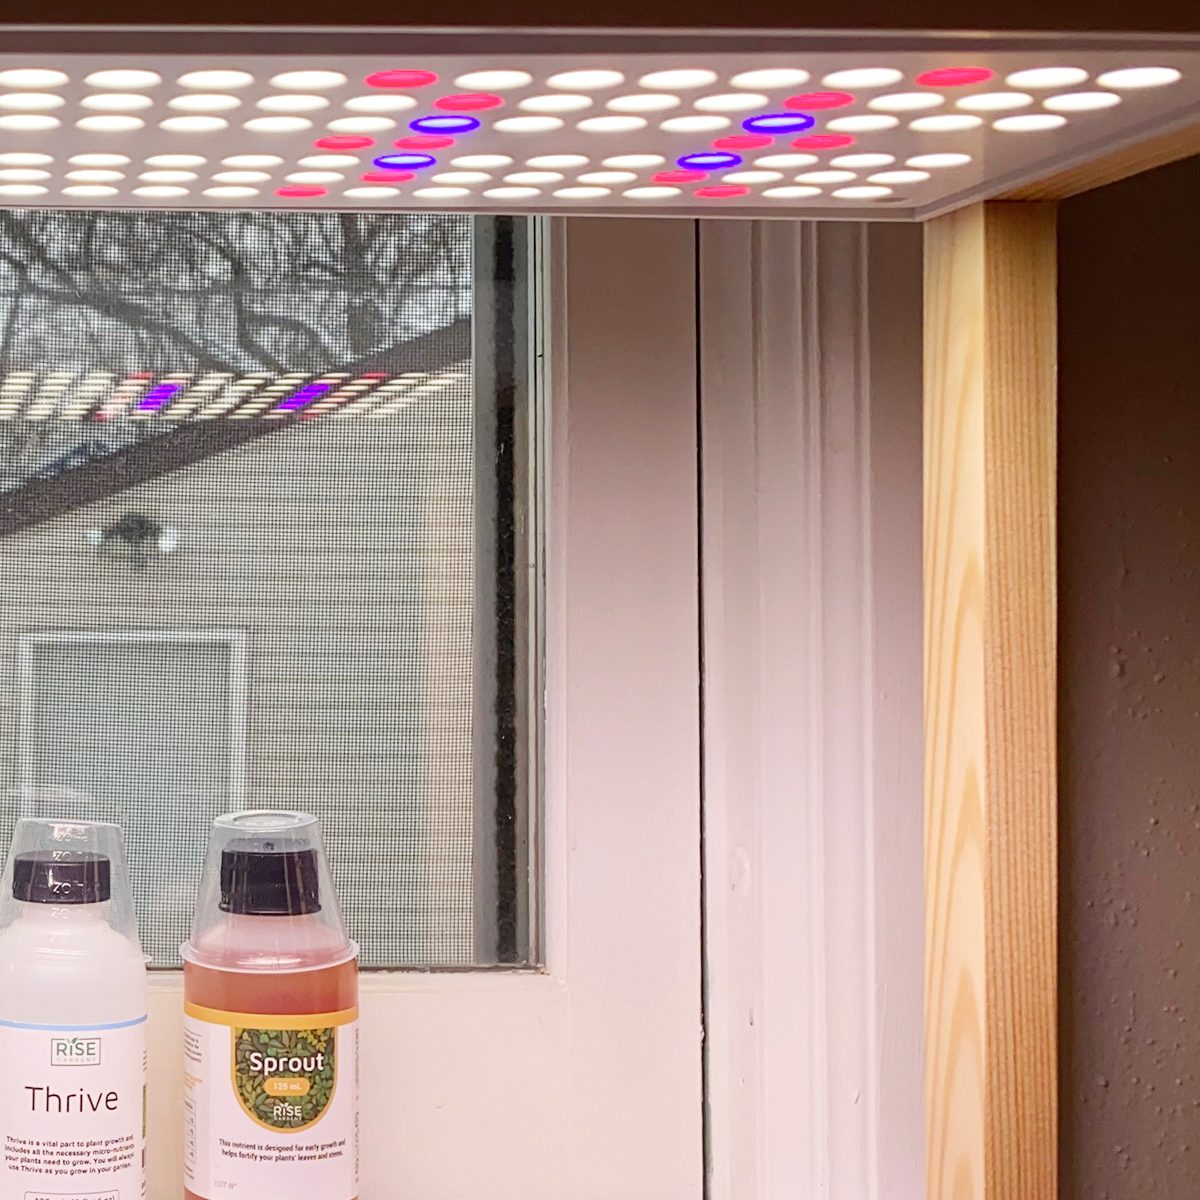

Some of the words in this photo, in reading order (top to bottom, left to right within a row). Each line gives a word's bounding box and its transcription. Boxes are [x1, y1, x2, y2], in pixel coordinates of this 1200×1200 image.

[249, 1052, 324, 1076] Sprout
[273, 1082, 288, 1090] 125
[25, 1086, 118, 1113] Thrive
[6, 1135, 26, 1145] Thrive
[60, 1140, 75, 1148] part
[85, 1138, 103, 1148] plant
[104, 1136, 124, 1146] growth
[219, 1138, 231, 1147] This
[232, 1141, 256, 1150] nutrient
[257, 1143, 263, 1151] is
[264, 1144, 293, 1153] designed
[295, 1144, 304, 1152] for
[305, 1143, 319, 1152] early
[320, 1140, 337, 1151] growth
[4, 1144, 30, 1155] includes
[32, 1147, 40, 1155] all
[42, 1147, 54, 1156] the
[56, 1149, 91, 1157] necessary
[221, 1148, 237, 1158] helps
[239, 1151, 258, 1161] fortify
[259, 1154, 273, 1162] your
[297, 1153, 317, 1162] leaves
[318, 1152, 328, 1160] and
[20, 1156, 41, 1165] plants
[72, 1159, 92, 1167] grow.
[107, 1155, 117, 1163] will
[21, 1165, 42, 1174] Thrive
[55, 1168, 68, 1176] you
[70, 1168, 88, 1176] grow
[89, 1166, 96, 1174] in
[97, 1166, 111, 1175] your
[214, 1179, 227, 1188] LOT
